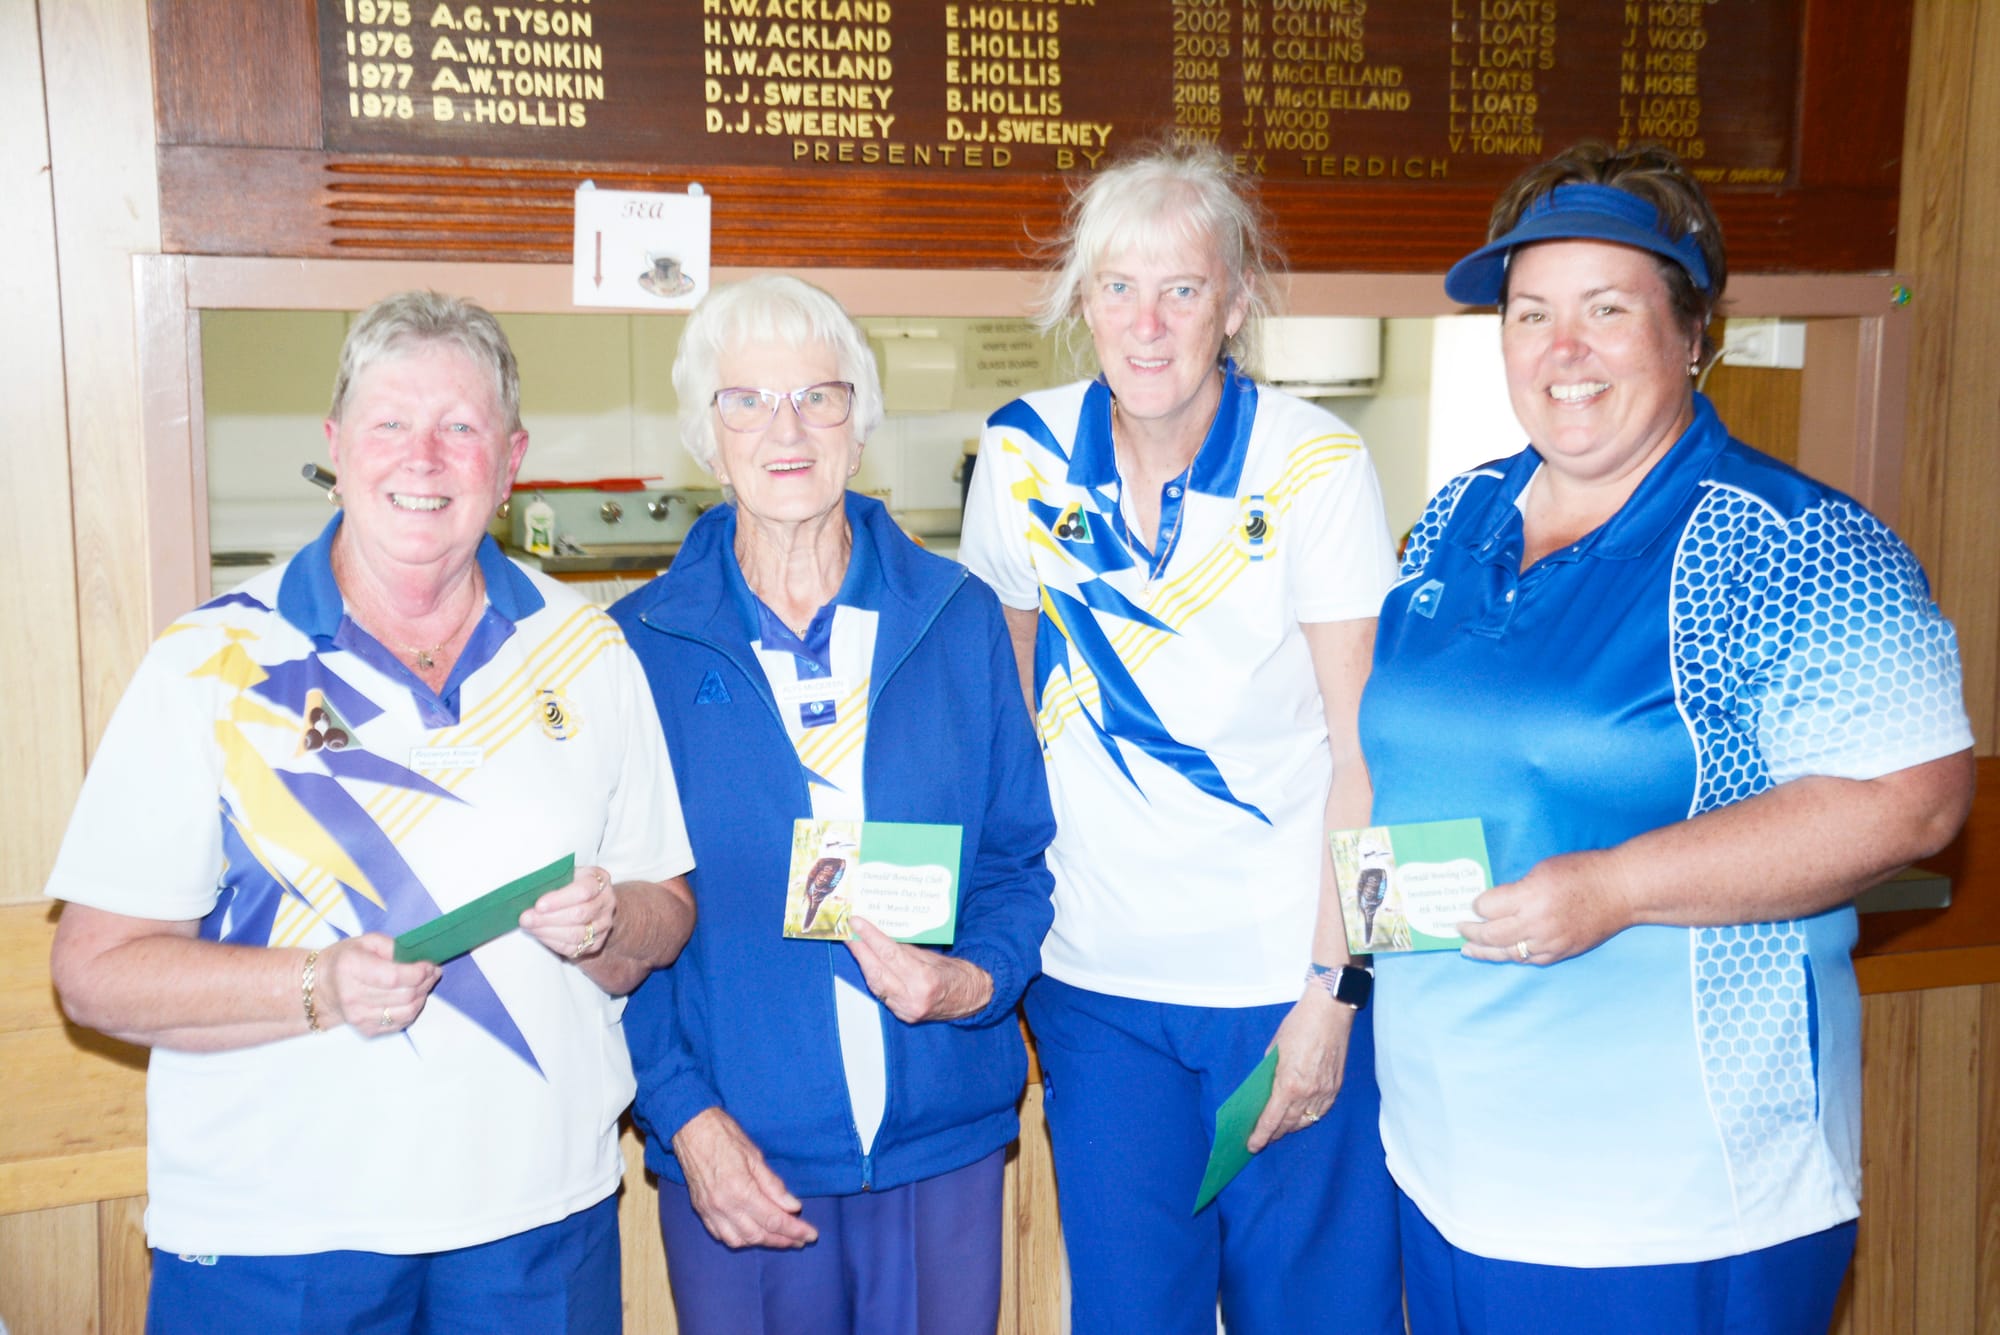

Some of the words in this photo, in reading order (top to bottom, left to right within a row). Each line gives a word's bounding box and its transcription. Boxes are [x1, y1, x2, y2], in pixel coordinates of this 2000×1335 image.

[345, 0, 411, 27] 1975
[430, 3, 592, 37] A.G.TYSON
[945, 5, 1059, 33] E.HOLLIS
[1173, 9, 1231, 34] 2002
[1272, 13, 1364, 40] COLLINS
[1481, 0, 1556, 23] LOATS
[1648, 5, 1702, 27] HOSE
[704, 19, 892, 53] H.W.ACKLAND
[946, 32, 1060, 60] E.HOLLIS
[1480, 22, 1556, 48] LOATS
[1648, 29, 1708, 51] WOOD
[346, 30, 413, 59] 1976
[431, 36, 602, 70] A.W.TONKIN
[1173, 35, 1230, 57] 2003
[1272, 40, 1364, 64] COLLINS
[1479, 47, 1555, 70] LOATS
[1645, 53, 1697, 73] HOSE
[705, 50, 893, 81] H.W.ACKLAND
[946, 59, 1061, 87] E.HOLLIS
[1173, 60, 1219, 81] 2004
[1242, 63, 1266, 83] W.
[1272, 65, 1403, 87] McCLELLAND
[348, 61, 413, 89] 1977
[431, 67, 604, 100] A.W.TONKIN
[1471, 70, 1534, 92] LOATS
[1644, 76, 1697, 95] HOSE
[350, 92, 414, 120] 1978
[705, 82, 894, 110] D.J.SWEENEY
[946, 89, 1062, 116] B.HOLLIS
[1173, 83, 1220, 105] 2005
[1243, 86, 1267, 107] W.
[1273, 87, 1410, 111] McCLELLAND
[1473, 93, 1538, 115] LOATS
[1640, 99, 1700, 120] LOATS
[705, 108, 895, 139] D.J.SWEENEY
[1174, 105, 1221, 126] 2006
[1264, 109, 1329, 129] WOOD
[1471, 115, 1534, 136] LOATS
[1639, 117, 1697, 137] WOOD
[946, 117, 1112, 147] D.J.SWEENEY
[1264, 131, 1329, 151] WOOD
[1470, 134, 1543, 156] TONKIN
[792, 141, 1013, 167] PRESENTED
[1056, 149, 1105, 170] BY
[1302, 155, 1449, 179] TERDICH
[622, 201, 664, 219] TEA
